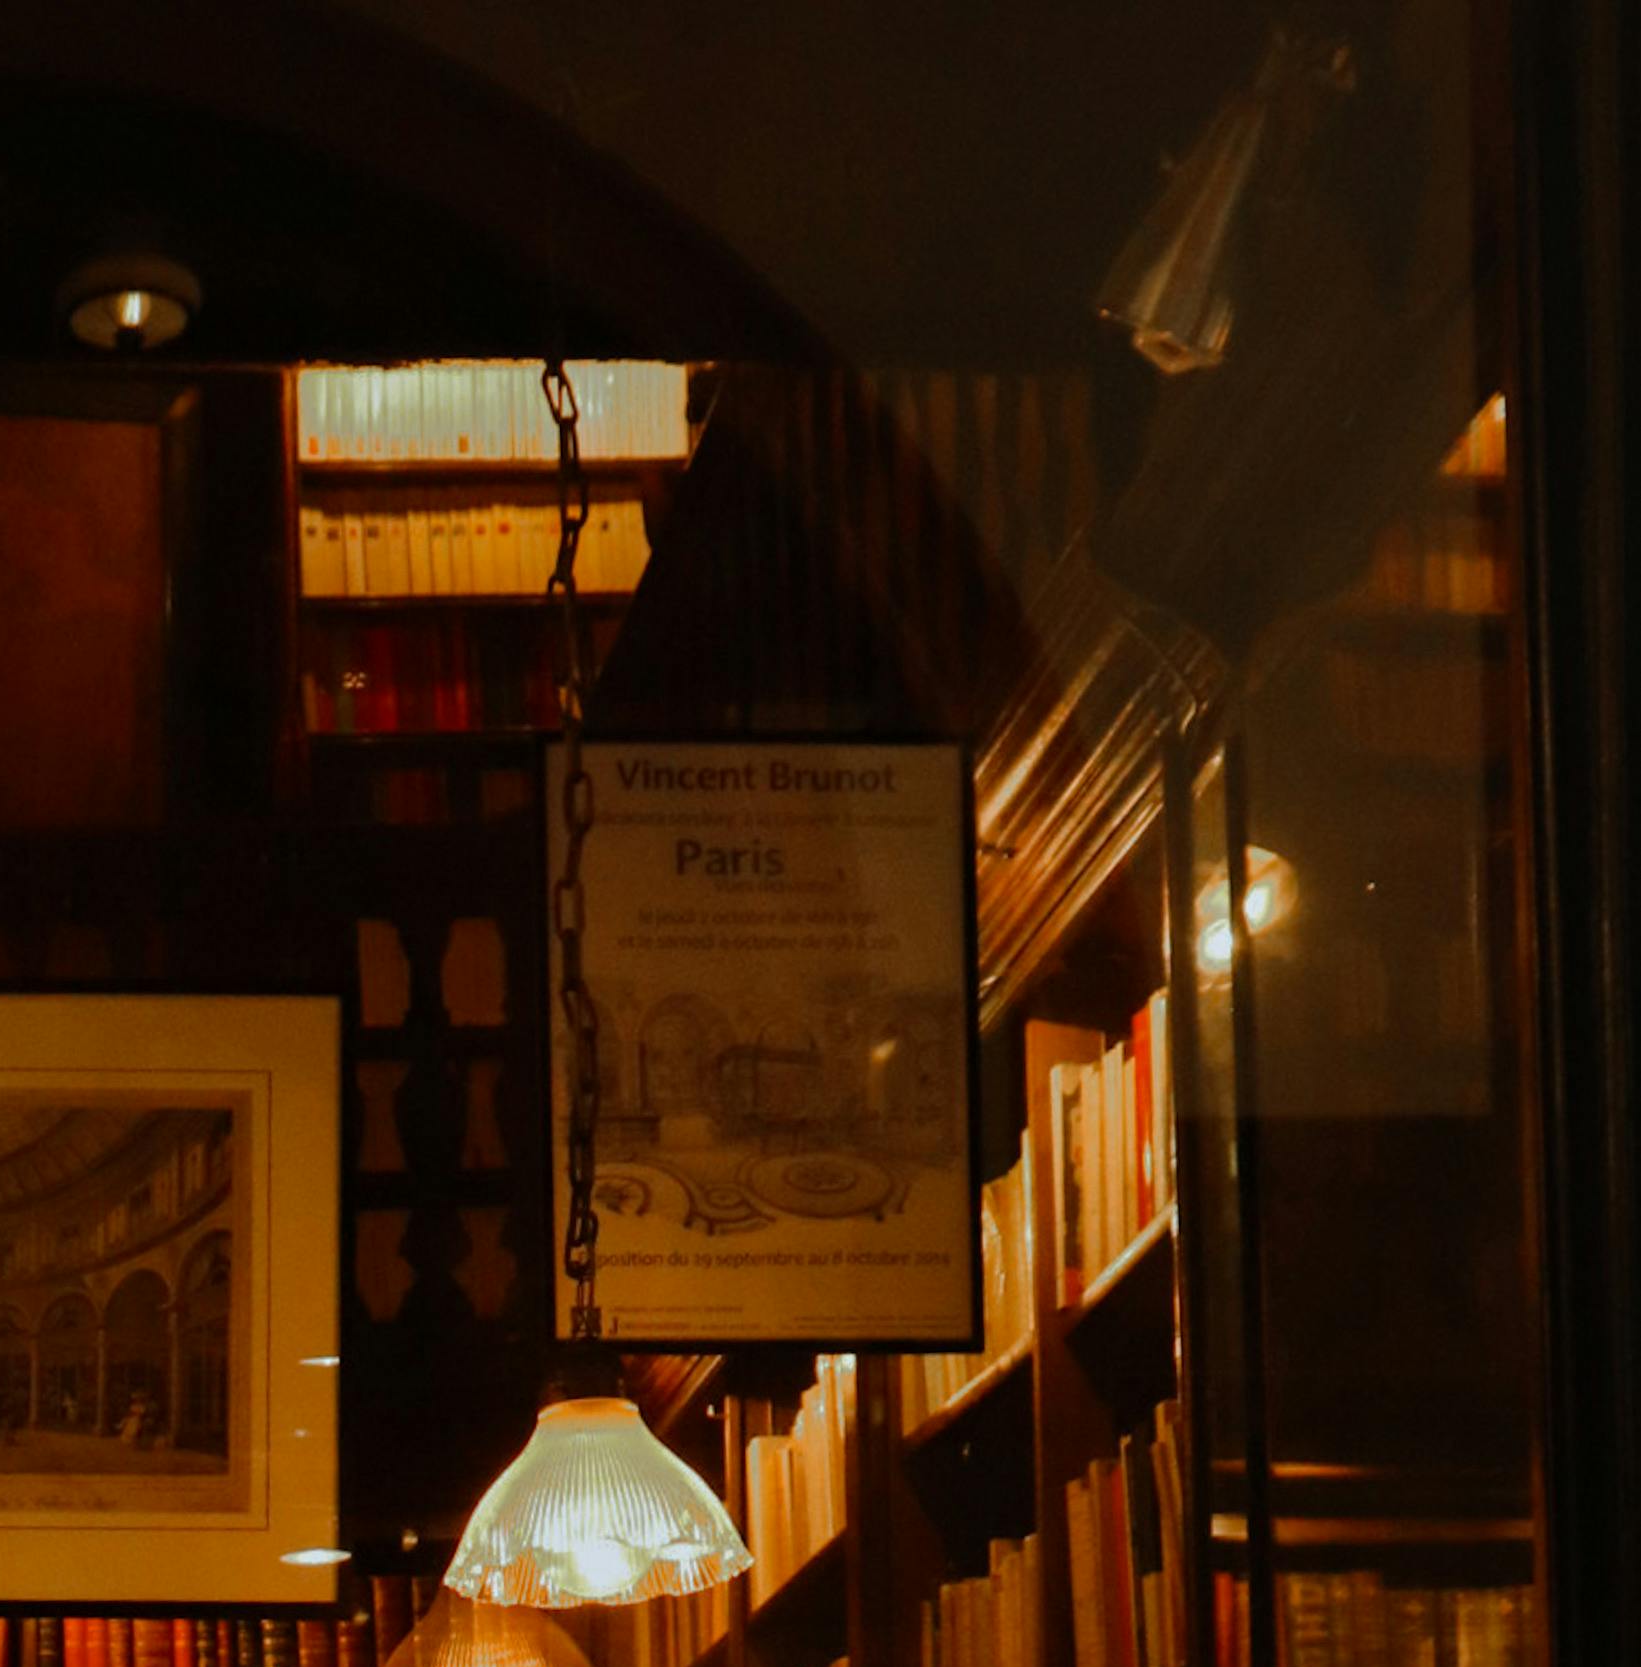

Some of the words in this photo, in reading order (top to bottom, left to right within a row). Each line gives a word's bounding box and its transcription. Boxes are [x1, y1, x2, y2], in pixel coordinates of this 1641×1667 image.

[617, 760, 756, 793] Vincent
[769, 761, 896, 793] Brunot
[676, 838, 785, 877] Paris
[578, 1249, 662, 1270] position
[667, 1249, 689, 1267] du
